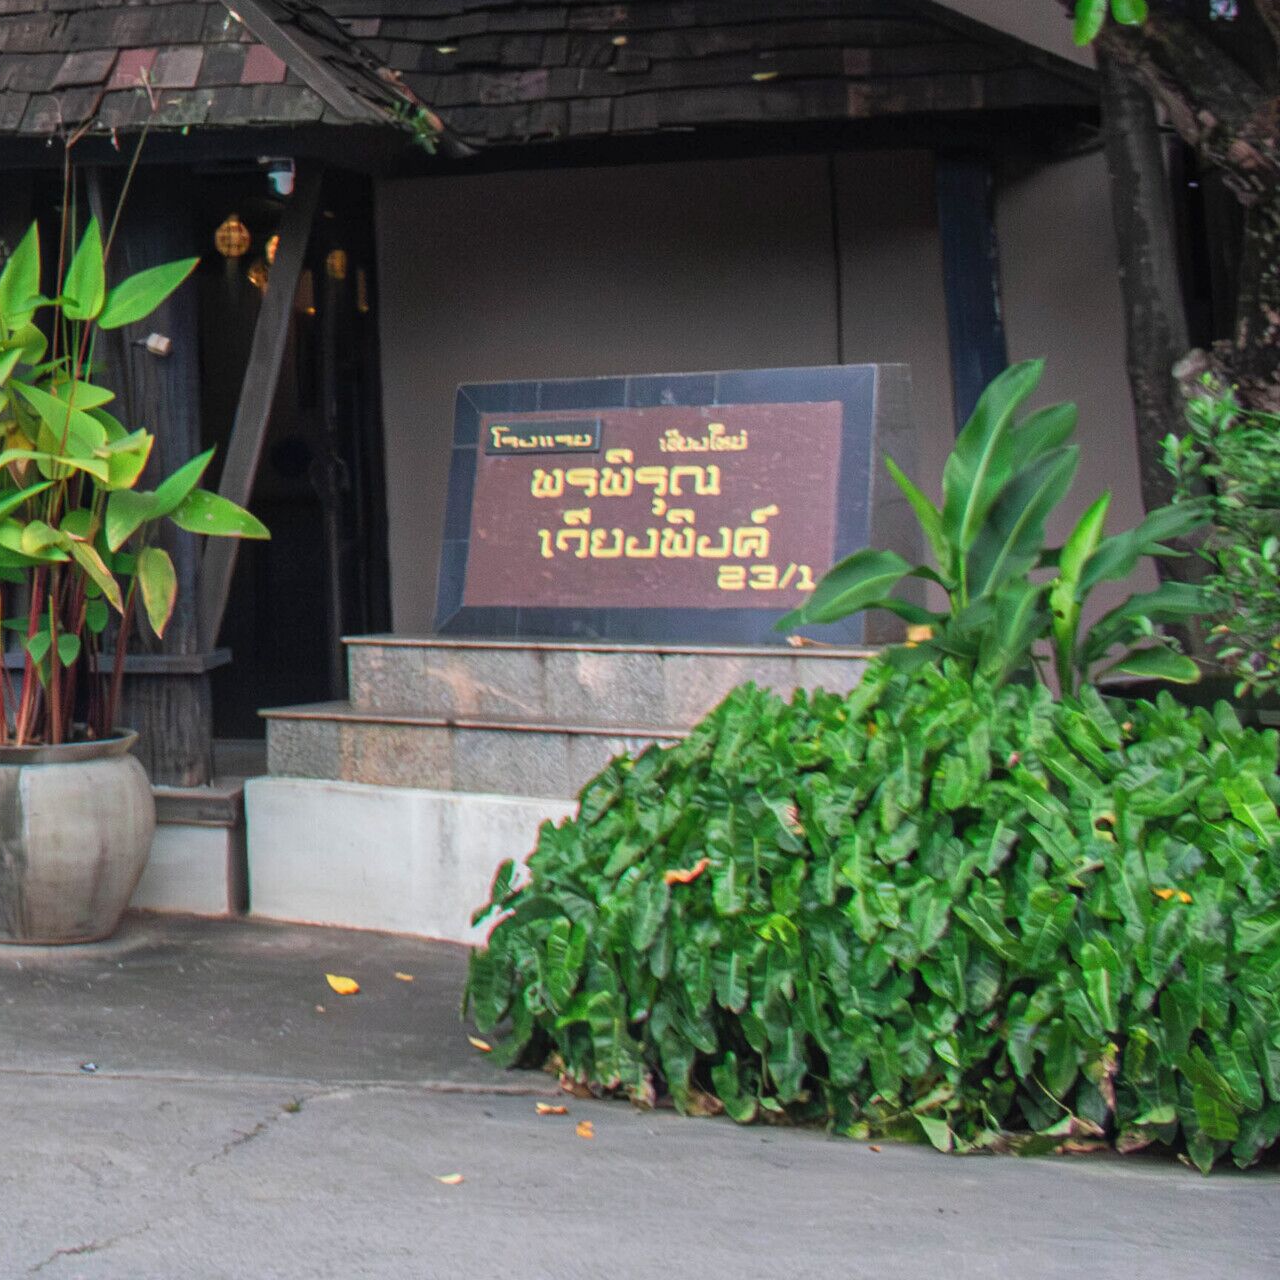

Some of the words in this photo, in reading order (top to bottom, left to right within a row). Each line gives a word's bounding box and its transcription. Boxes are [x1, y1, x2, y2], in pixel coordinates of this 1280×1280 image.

[490, 426, 593, 448] โรงแรม
[659, 423, 748, 452] เชียงใหม่
[531, 448, 721, 517] พรพิรุณ
[538, 504, 779, 558] เวียงพิงค์
[717, 561, 816, 590] 23/1
